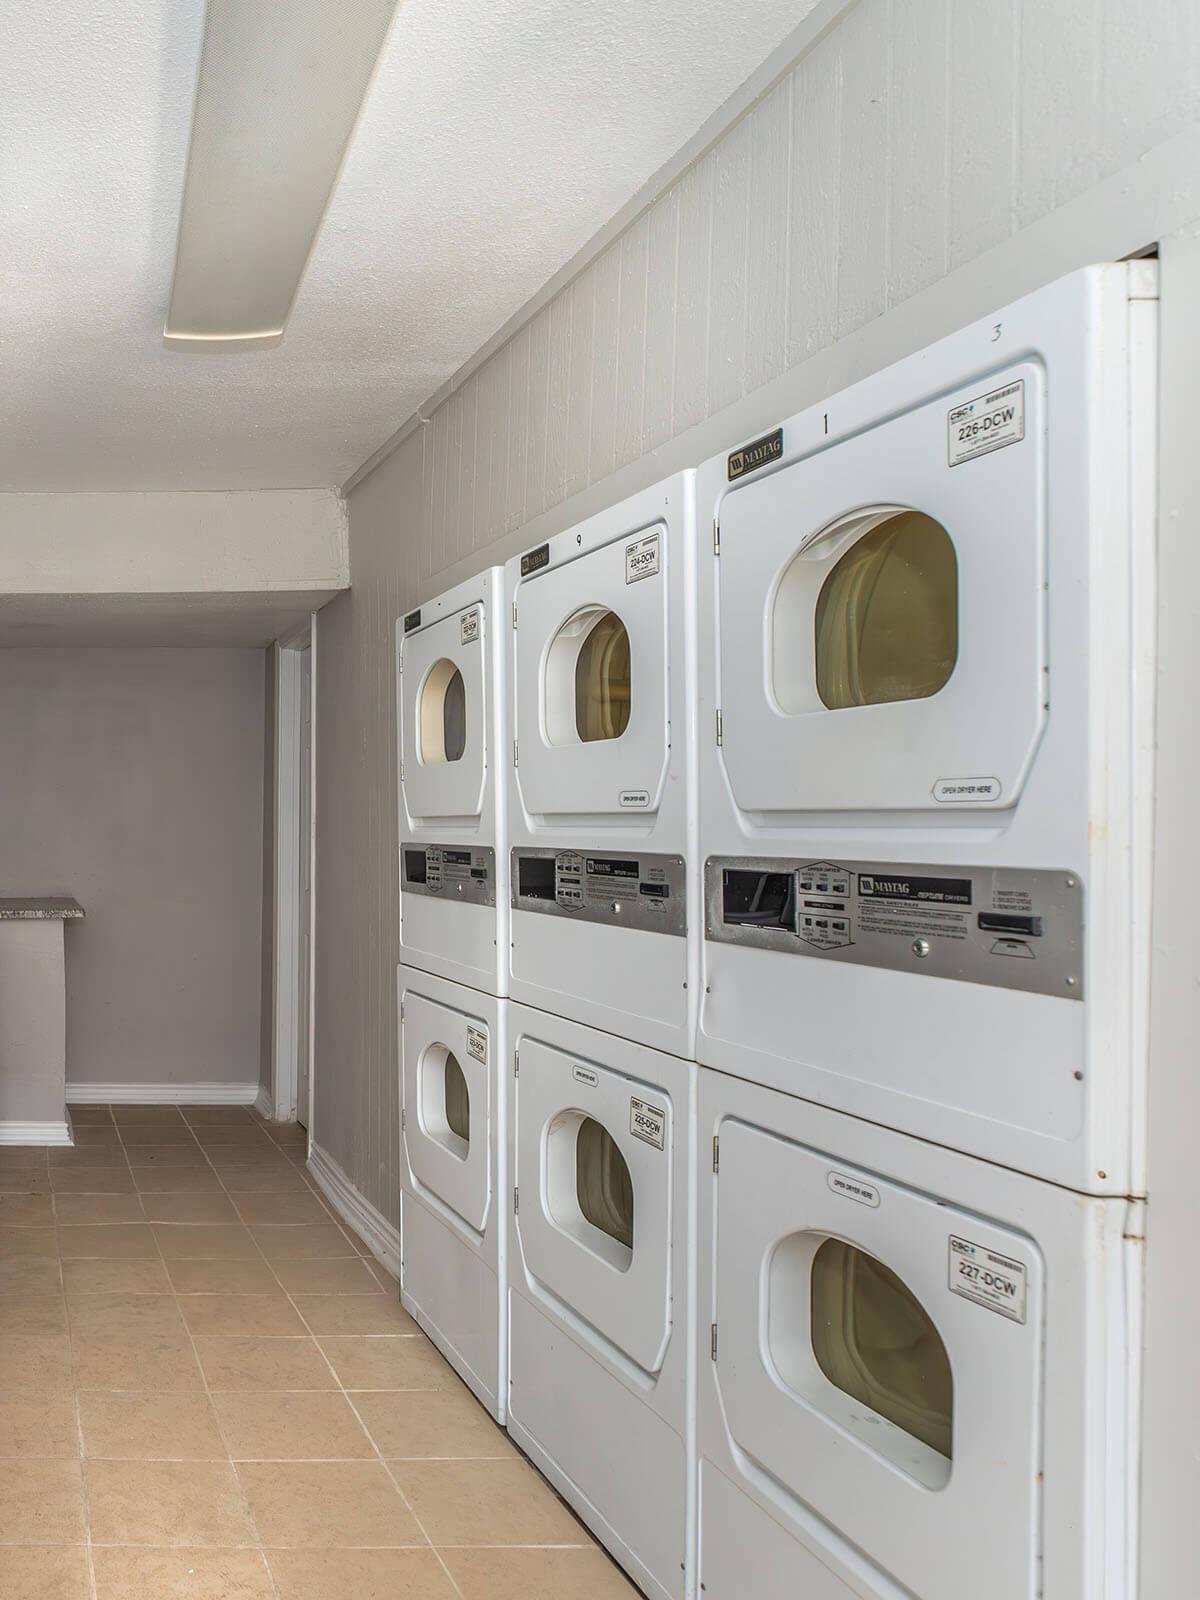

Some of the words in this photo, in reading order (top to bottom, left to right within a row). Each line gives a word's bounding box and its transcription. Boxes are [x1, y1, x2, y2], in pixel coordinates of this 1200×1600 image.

[991, 322, 1003, 342] 3
[823, 413, 829, 435] 1
[958, 406, 1015, 441] 226-DCW
[744, 438, 781, 466] MAYTAG
[941, 786, 957, 795] OPEN
[957, 785, 977, 795] DRYER
[977, 784, 993, 794] HERE
[874, 881, 910, 894] MAYTAG
[833, 1179, 846, 1189] OPEN
[845, 1184, 861, 1195] DRYER
[861, 1190, 873, 1201] HERE
[959, 1261, 1016, 1297] 227-DCW
